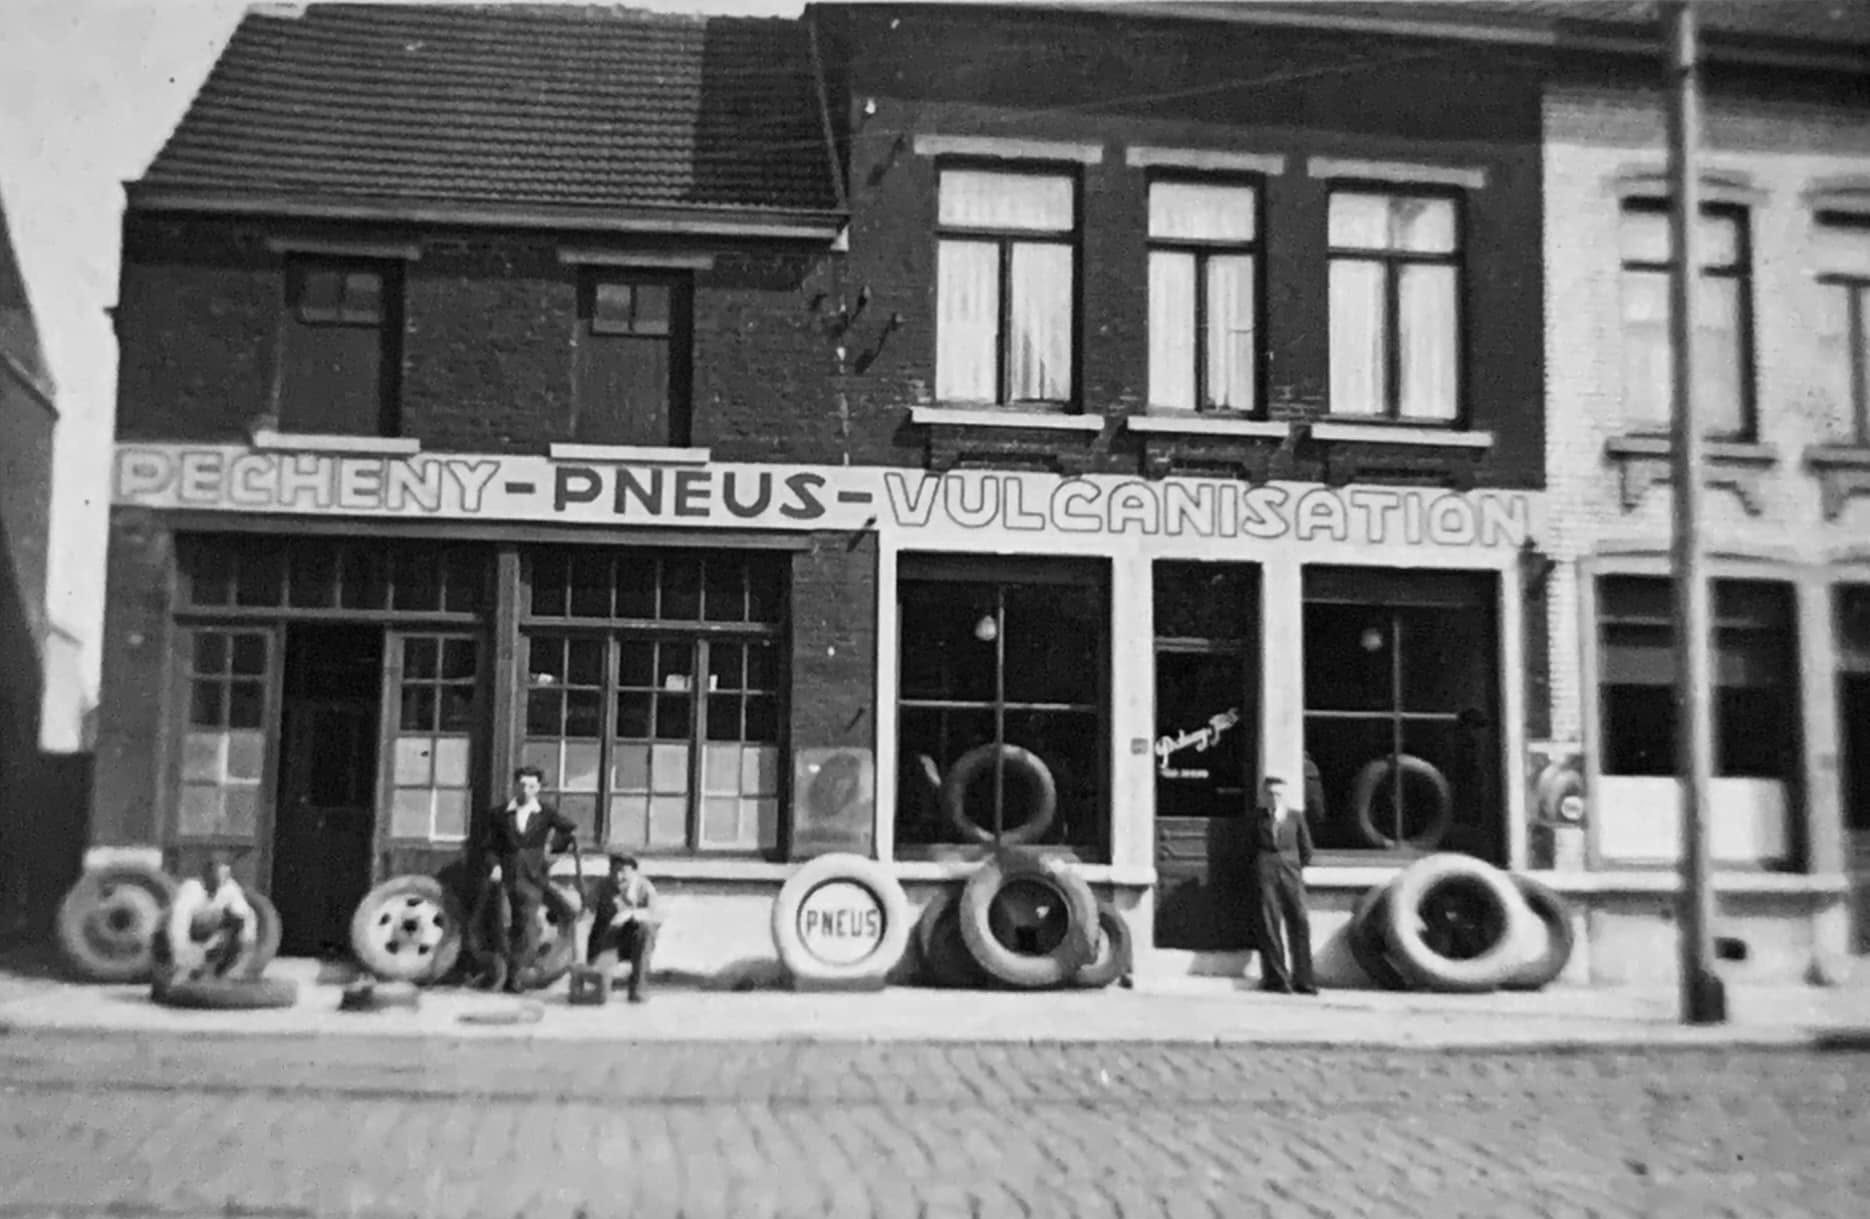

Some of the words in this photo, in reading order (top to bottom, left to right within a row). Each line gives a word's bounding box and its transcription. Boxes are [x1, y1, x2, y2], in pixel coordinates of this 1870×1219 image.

[115, 450, 500, 513] PECHENY
[553, 465, 827, 520] PNEUS
[884, 471, 1530, 547] VULCANISATION
[806, 908, 878, 937] PNEUS
